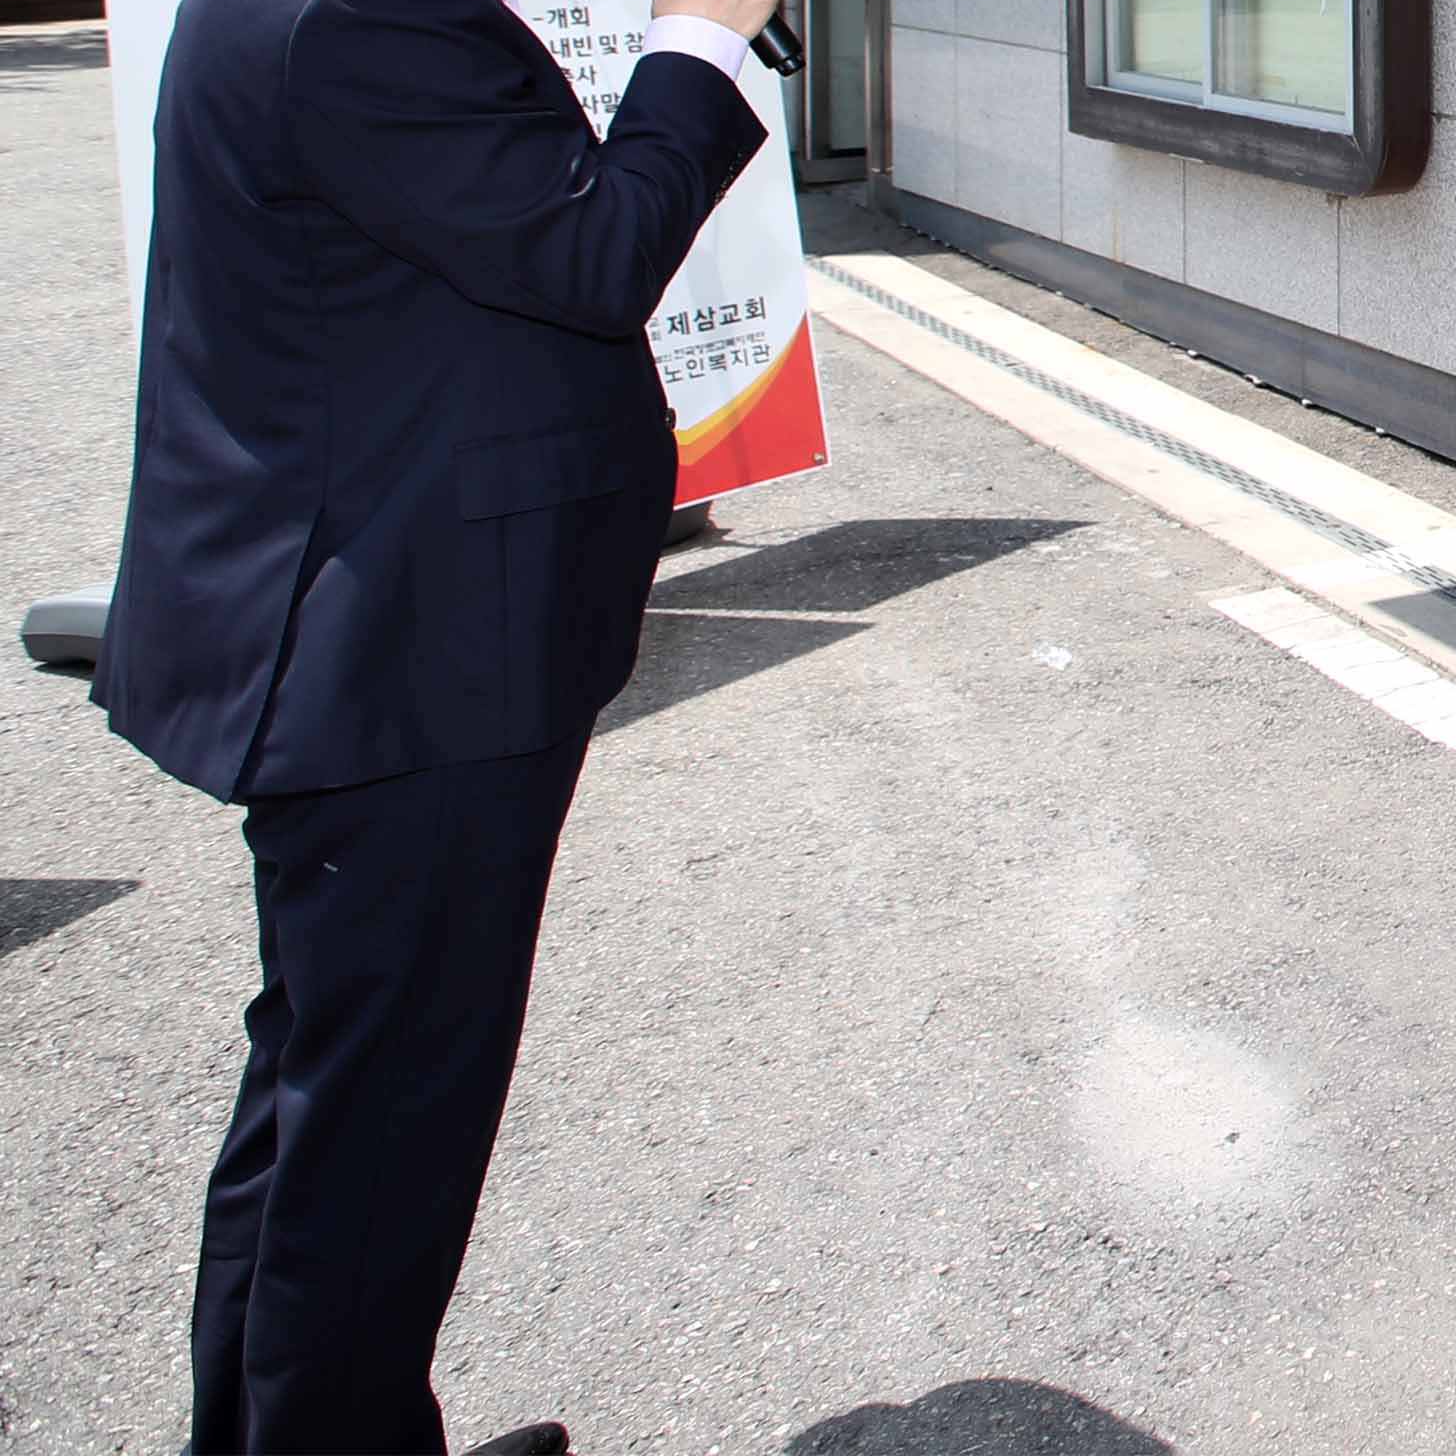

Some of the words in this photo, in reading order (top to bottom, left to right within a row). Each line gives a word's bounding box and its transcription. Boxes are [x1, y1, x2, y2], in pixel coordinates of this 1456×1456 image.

[548, 35, 593, 58] 내빈
[598, 33, 619, 55] 및
[667, 296, 767, 336] 제삼교회
[664, 343, 771, 384] 노인복지관
